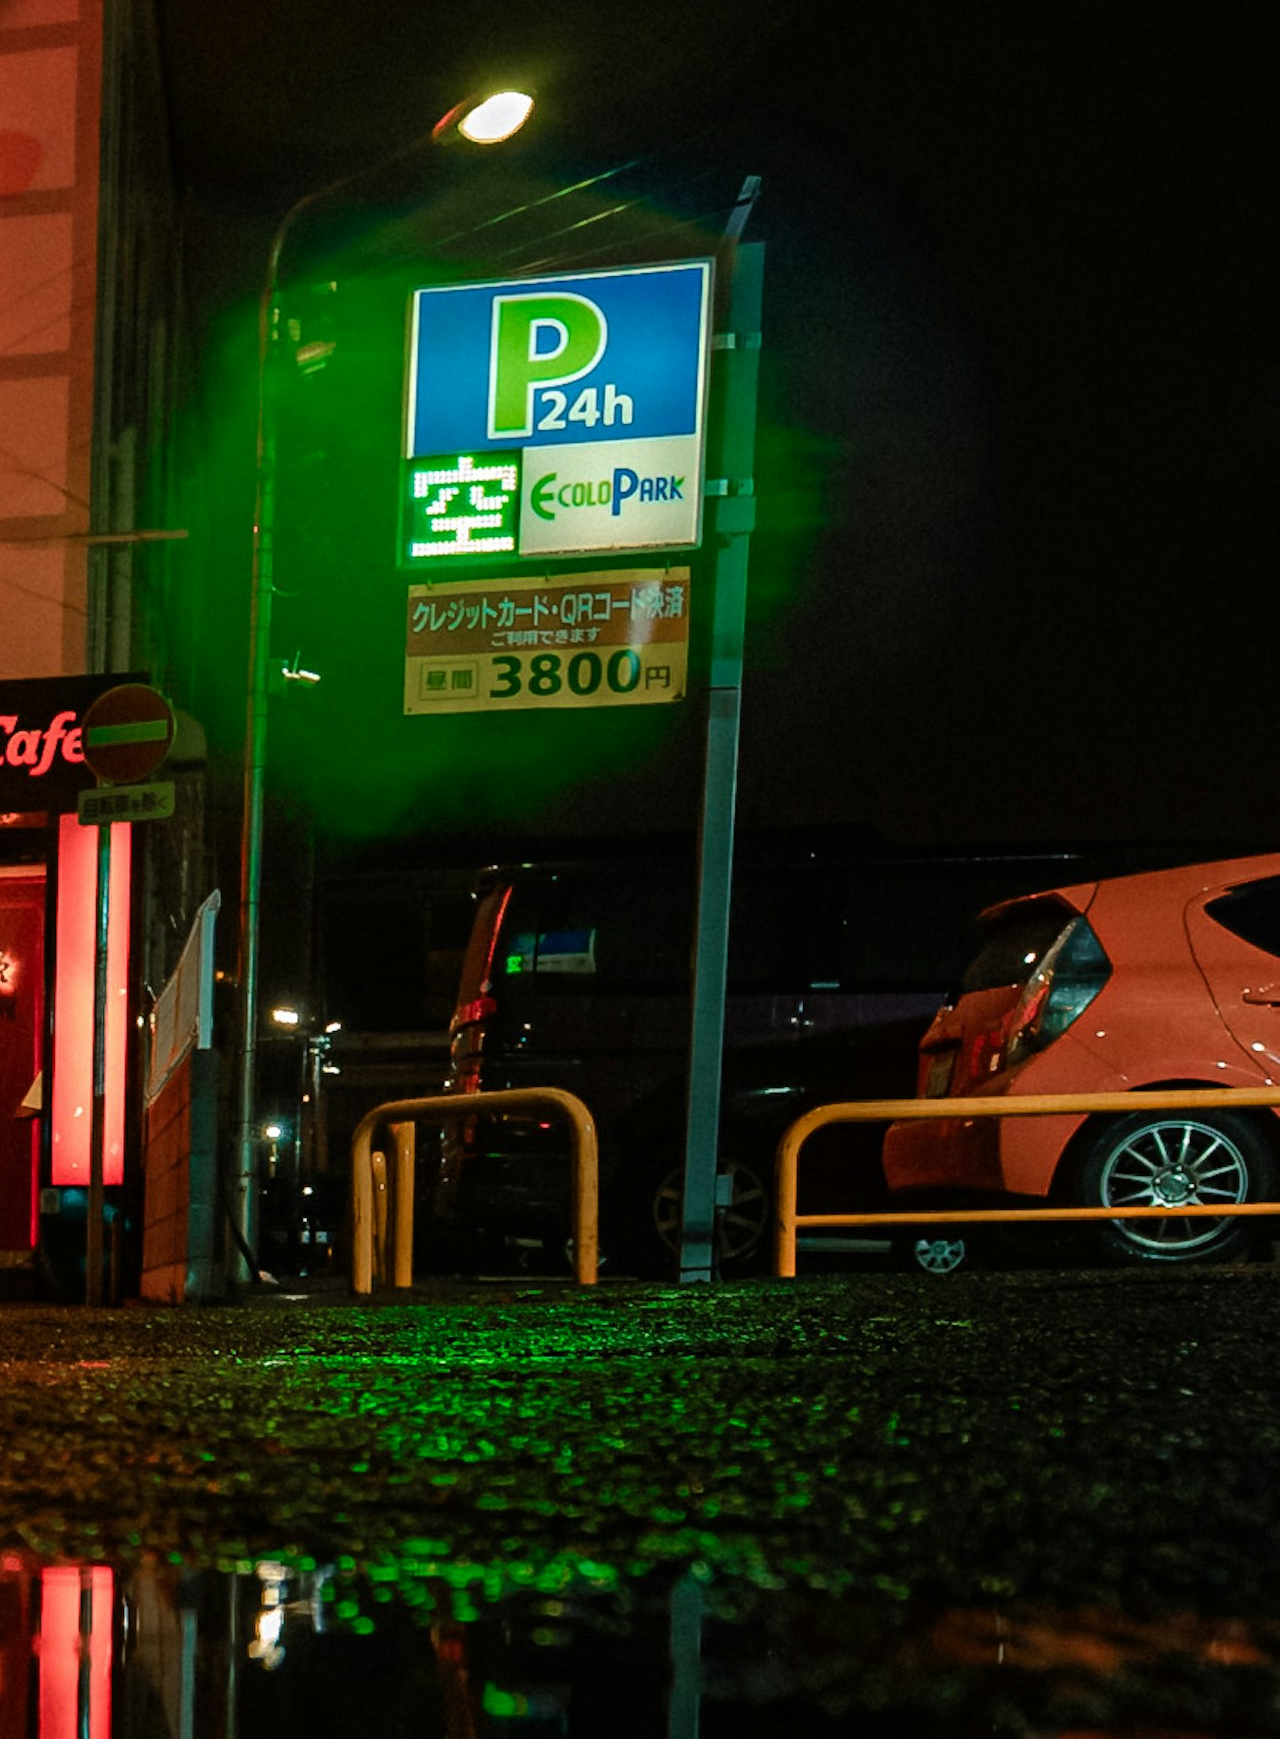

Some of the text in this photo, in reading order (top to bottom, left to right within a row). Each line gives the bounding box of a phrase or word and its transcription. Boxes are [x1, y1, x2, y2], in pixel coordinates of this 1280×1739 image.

[487, 291, 634, 440] P 24h
[411, 455, 517, 557] 空
